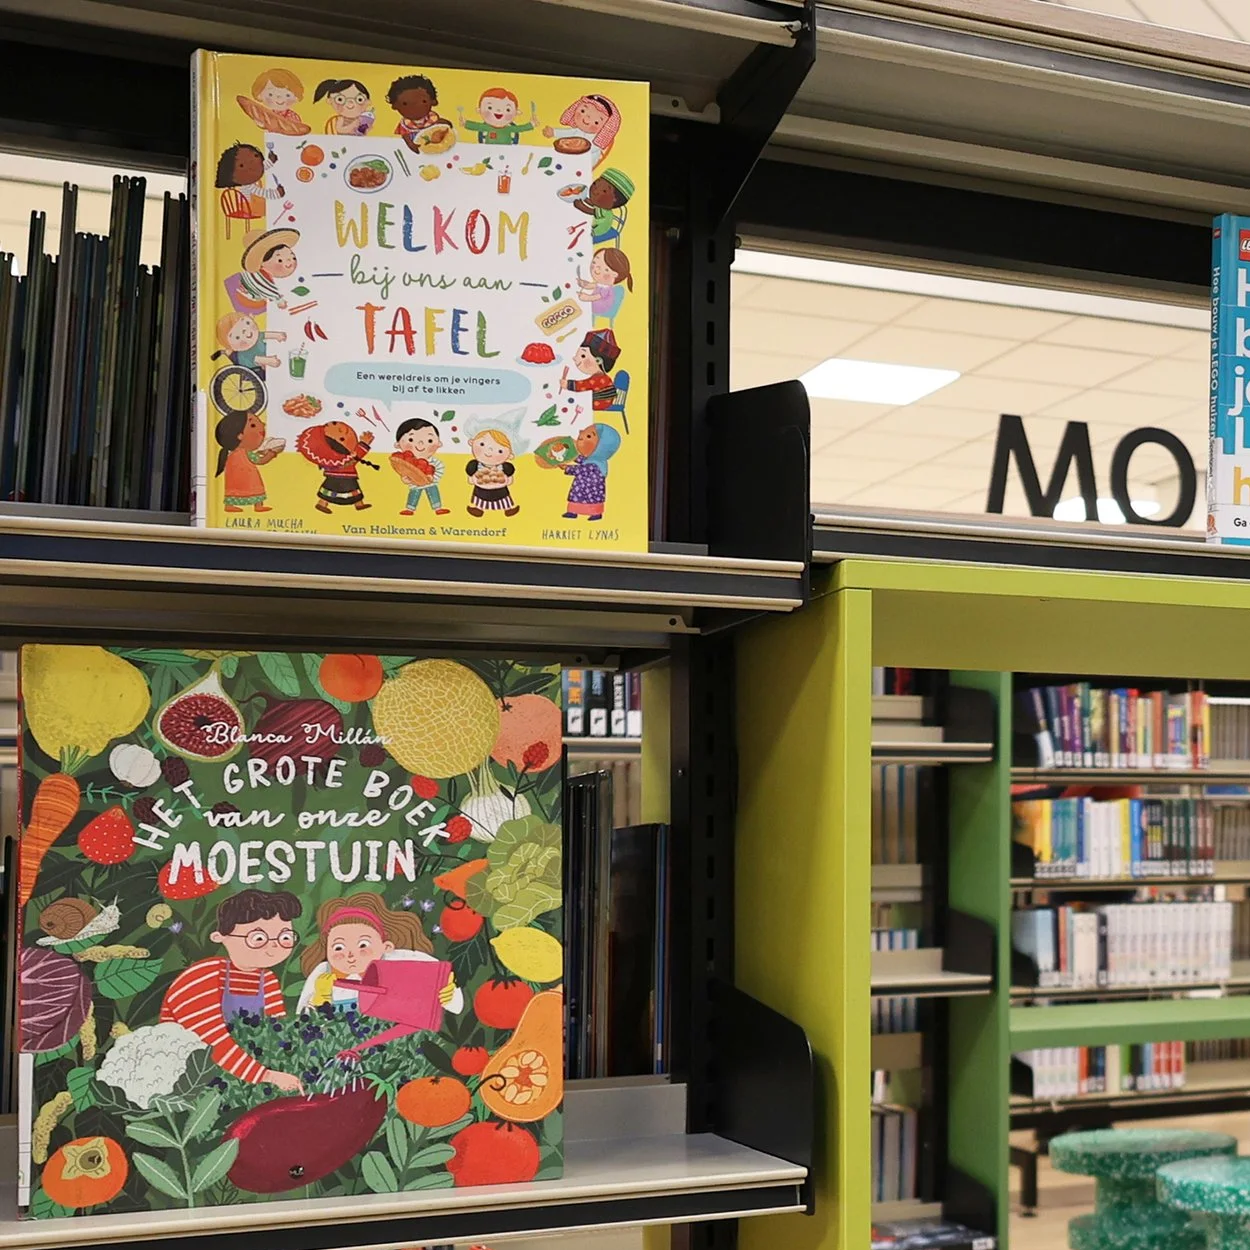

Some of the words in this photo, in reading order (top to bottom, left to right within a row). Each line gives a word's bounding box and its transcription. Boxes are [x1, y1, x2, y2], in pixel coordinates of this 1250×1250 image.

[334, 199, 529, 261] WELKOM
[350, 254, 396, 299] bij
[402, 272, 457, 291] ons
[462, 274, 512, 293] aan
[356, 303, 500, 359] TAFEL
[356, 371, 375, 381] Een
[378, 373, 431, 383] wereldreis
[451, 375, 460, 385] je
[463, 376, 501, 386] vingers
[1210, 353, 1218, 390] LEGO
[392, 385, 405, 394] bij
[407, 385, 419, 393] af
[422, 386, 433, 394] te
[436, 386, 466, 395] likken
[225, 517, 260, 528] LAURA
[266, 518, 304, 528] MUCHA
[341, 524, 367, 535] Van
[370, 525, 425, 536] Holkema
[429, 527, 437, 536] &
[440, 526, 507, 537] Warendorf
[1233, 518, 1247, 527] Ga
[542, 529, 582, 540] HARRIET
[588, 529, 620, 541] LYNAS
[200, 721, 293, 745] Blanca
[301, 723, 394, 745] Millán
[132, 779, 201, 850] HET
[223, 755, 347, 794] GROTE
[363, 770, 451, 847] BOEK
[203, 808, 286, 828] van
[298, 808, 391, 828] onze
[168, 838, 417, 885] MOESTUIN
